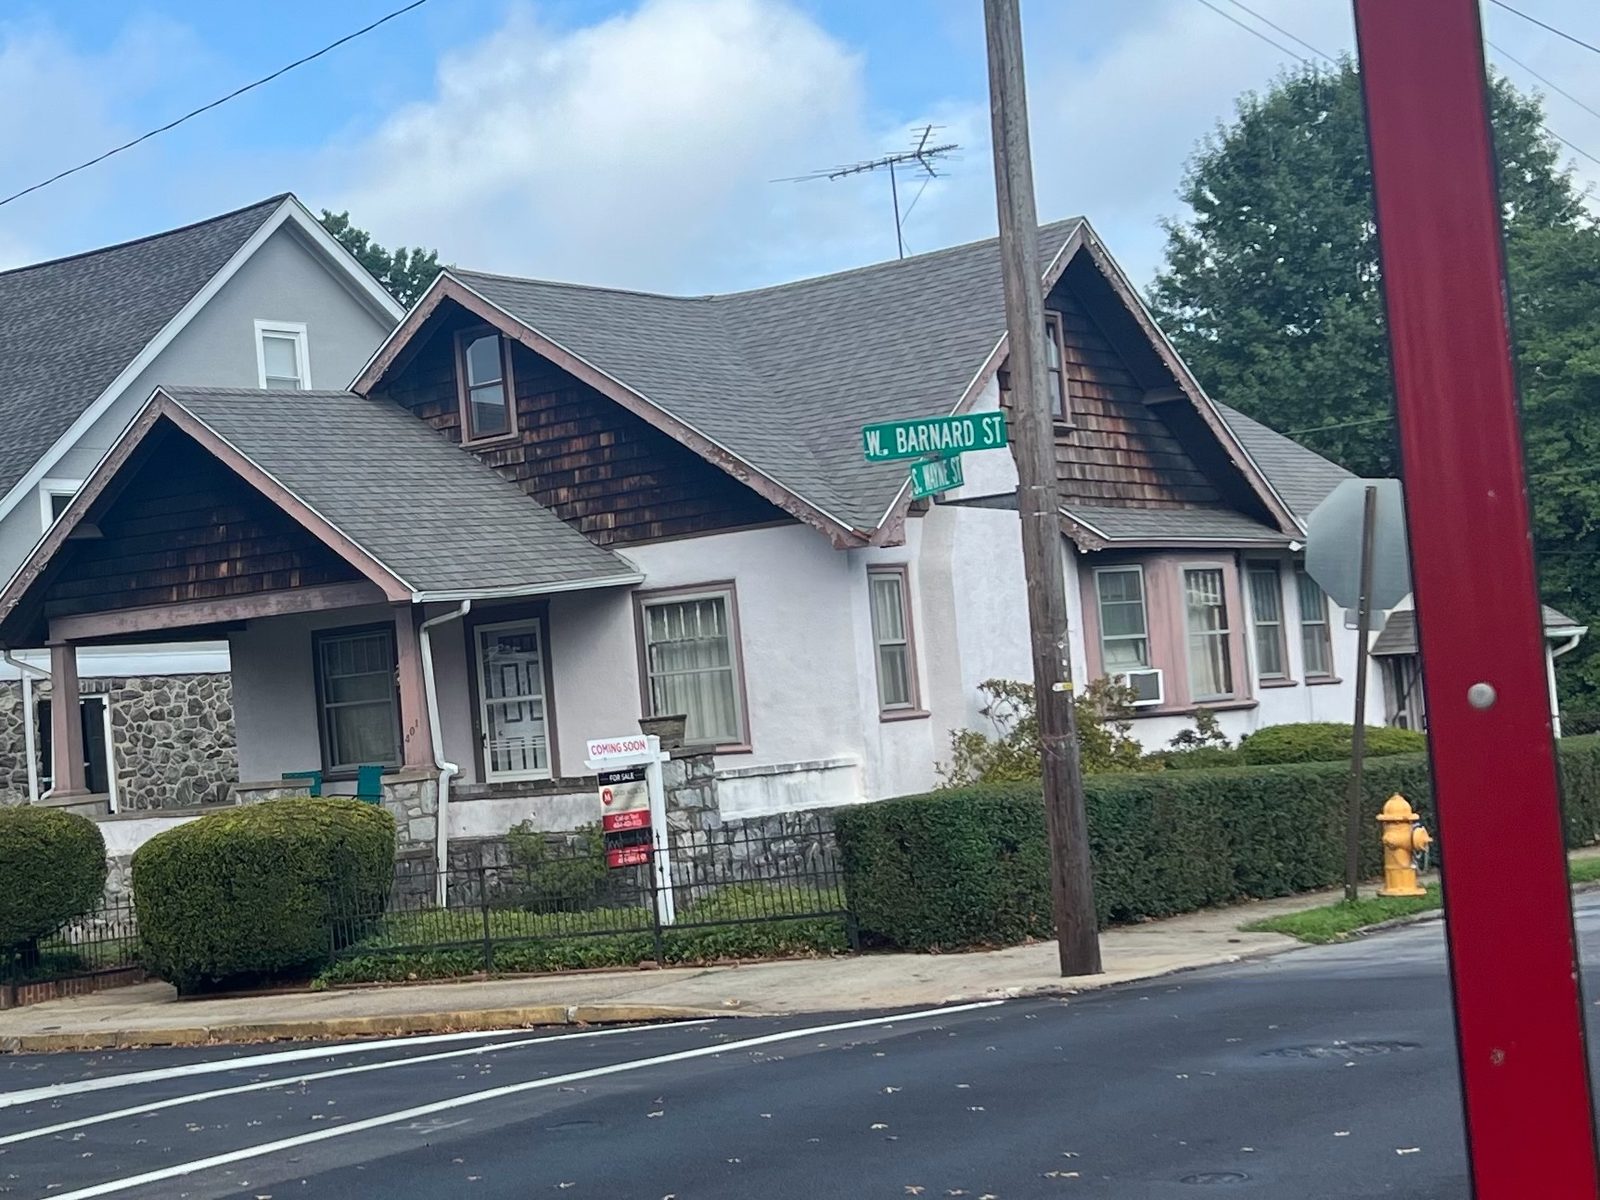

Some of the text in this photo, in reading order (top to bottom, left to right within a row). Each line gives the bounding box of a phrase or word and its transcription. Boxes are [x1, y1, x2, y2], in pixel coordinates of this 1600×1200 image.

[865, 416, 1002, 456] W. BARNARD ST
[922, 460, 950, 491] WAYNE
[950, 456, 962, 483] ST
[591, 740, 646, 756] COMING SOON
[609, 772, 635, 782] FOR SALE
